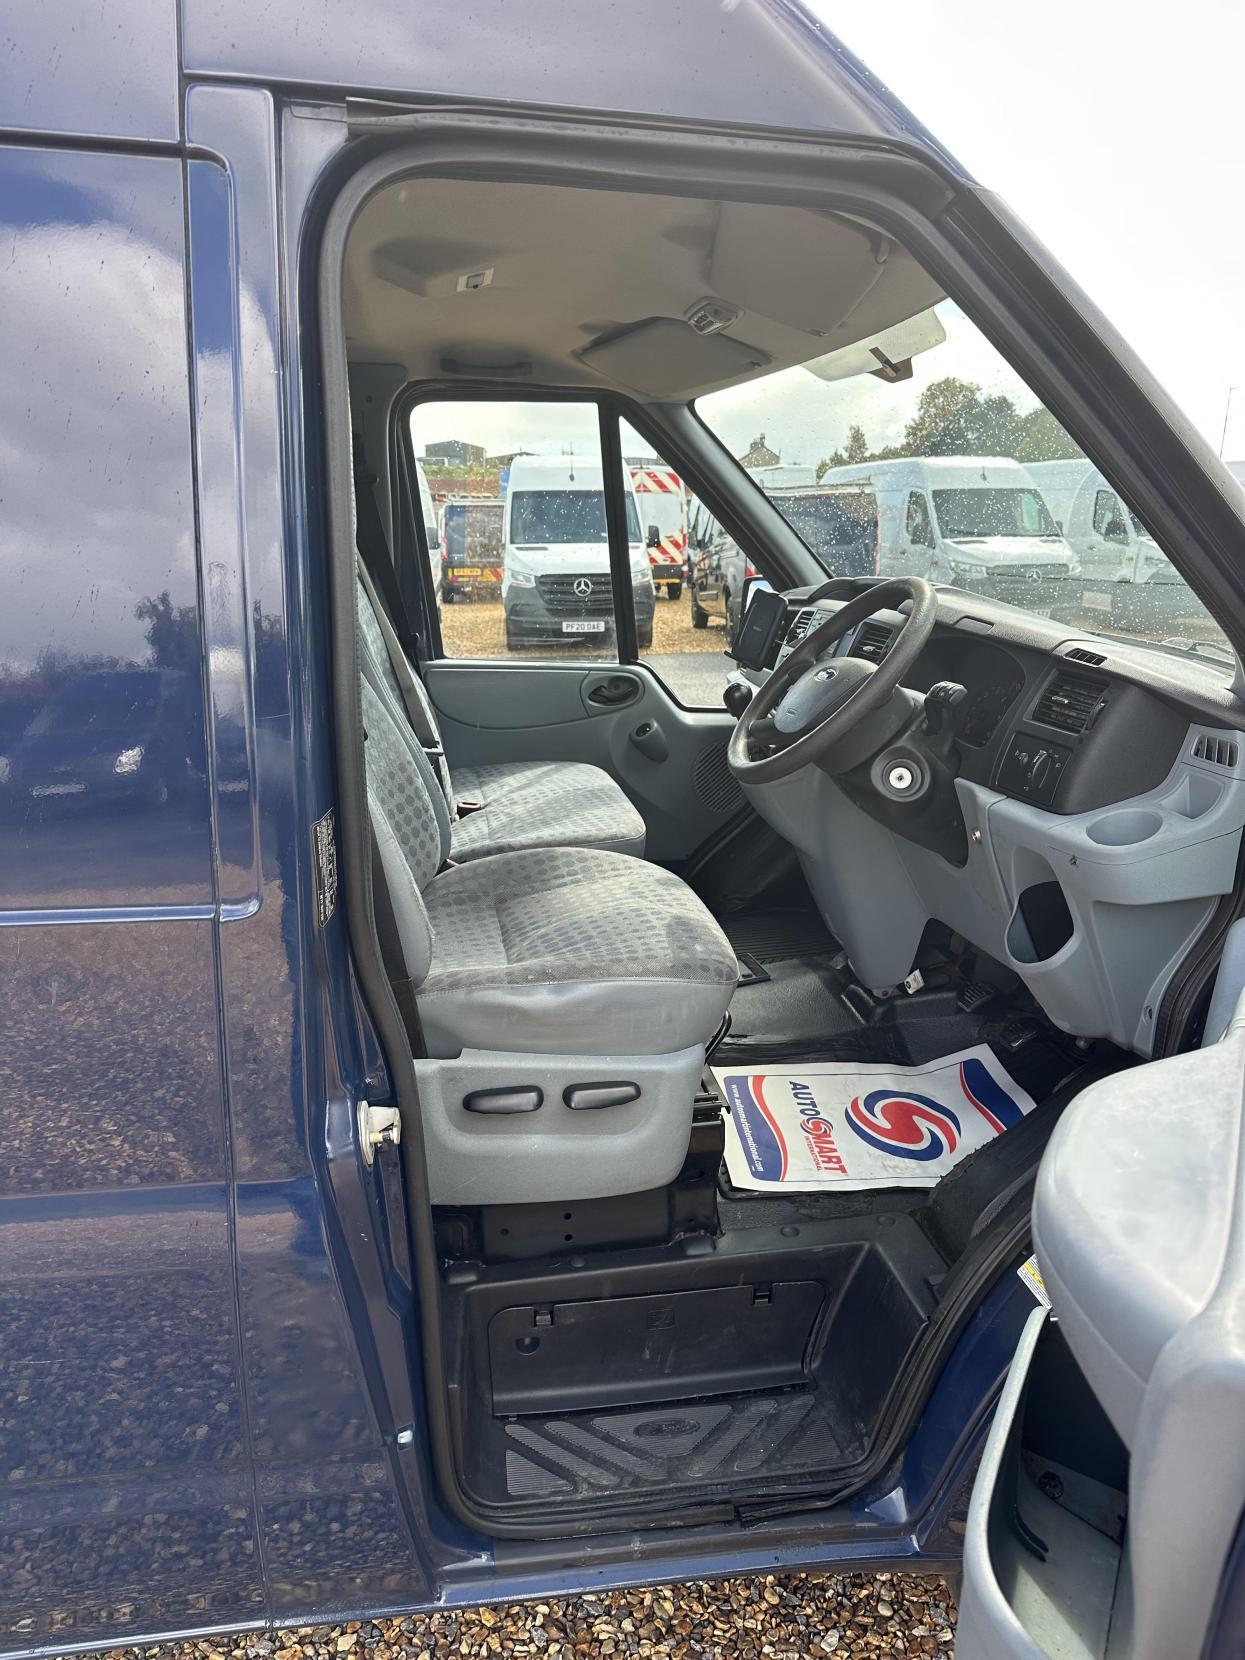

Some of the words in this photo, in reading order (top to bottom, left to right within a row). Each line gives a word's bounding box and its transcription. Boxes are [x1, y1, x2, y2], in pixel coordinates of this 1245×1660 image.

[565, 623, 585, 631] PF20
[730, 1084, 764, 1172] www.autosmartinternational.com
[804, 1135, 822, 1172] INTERNATIONAL
